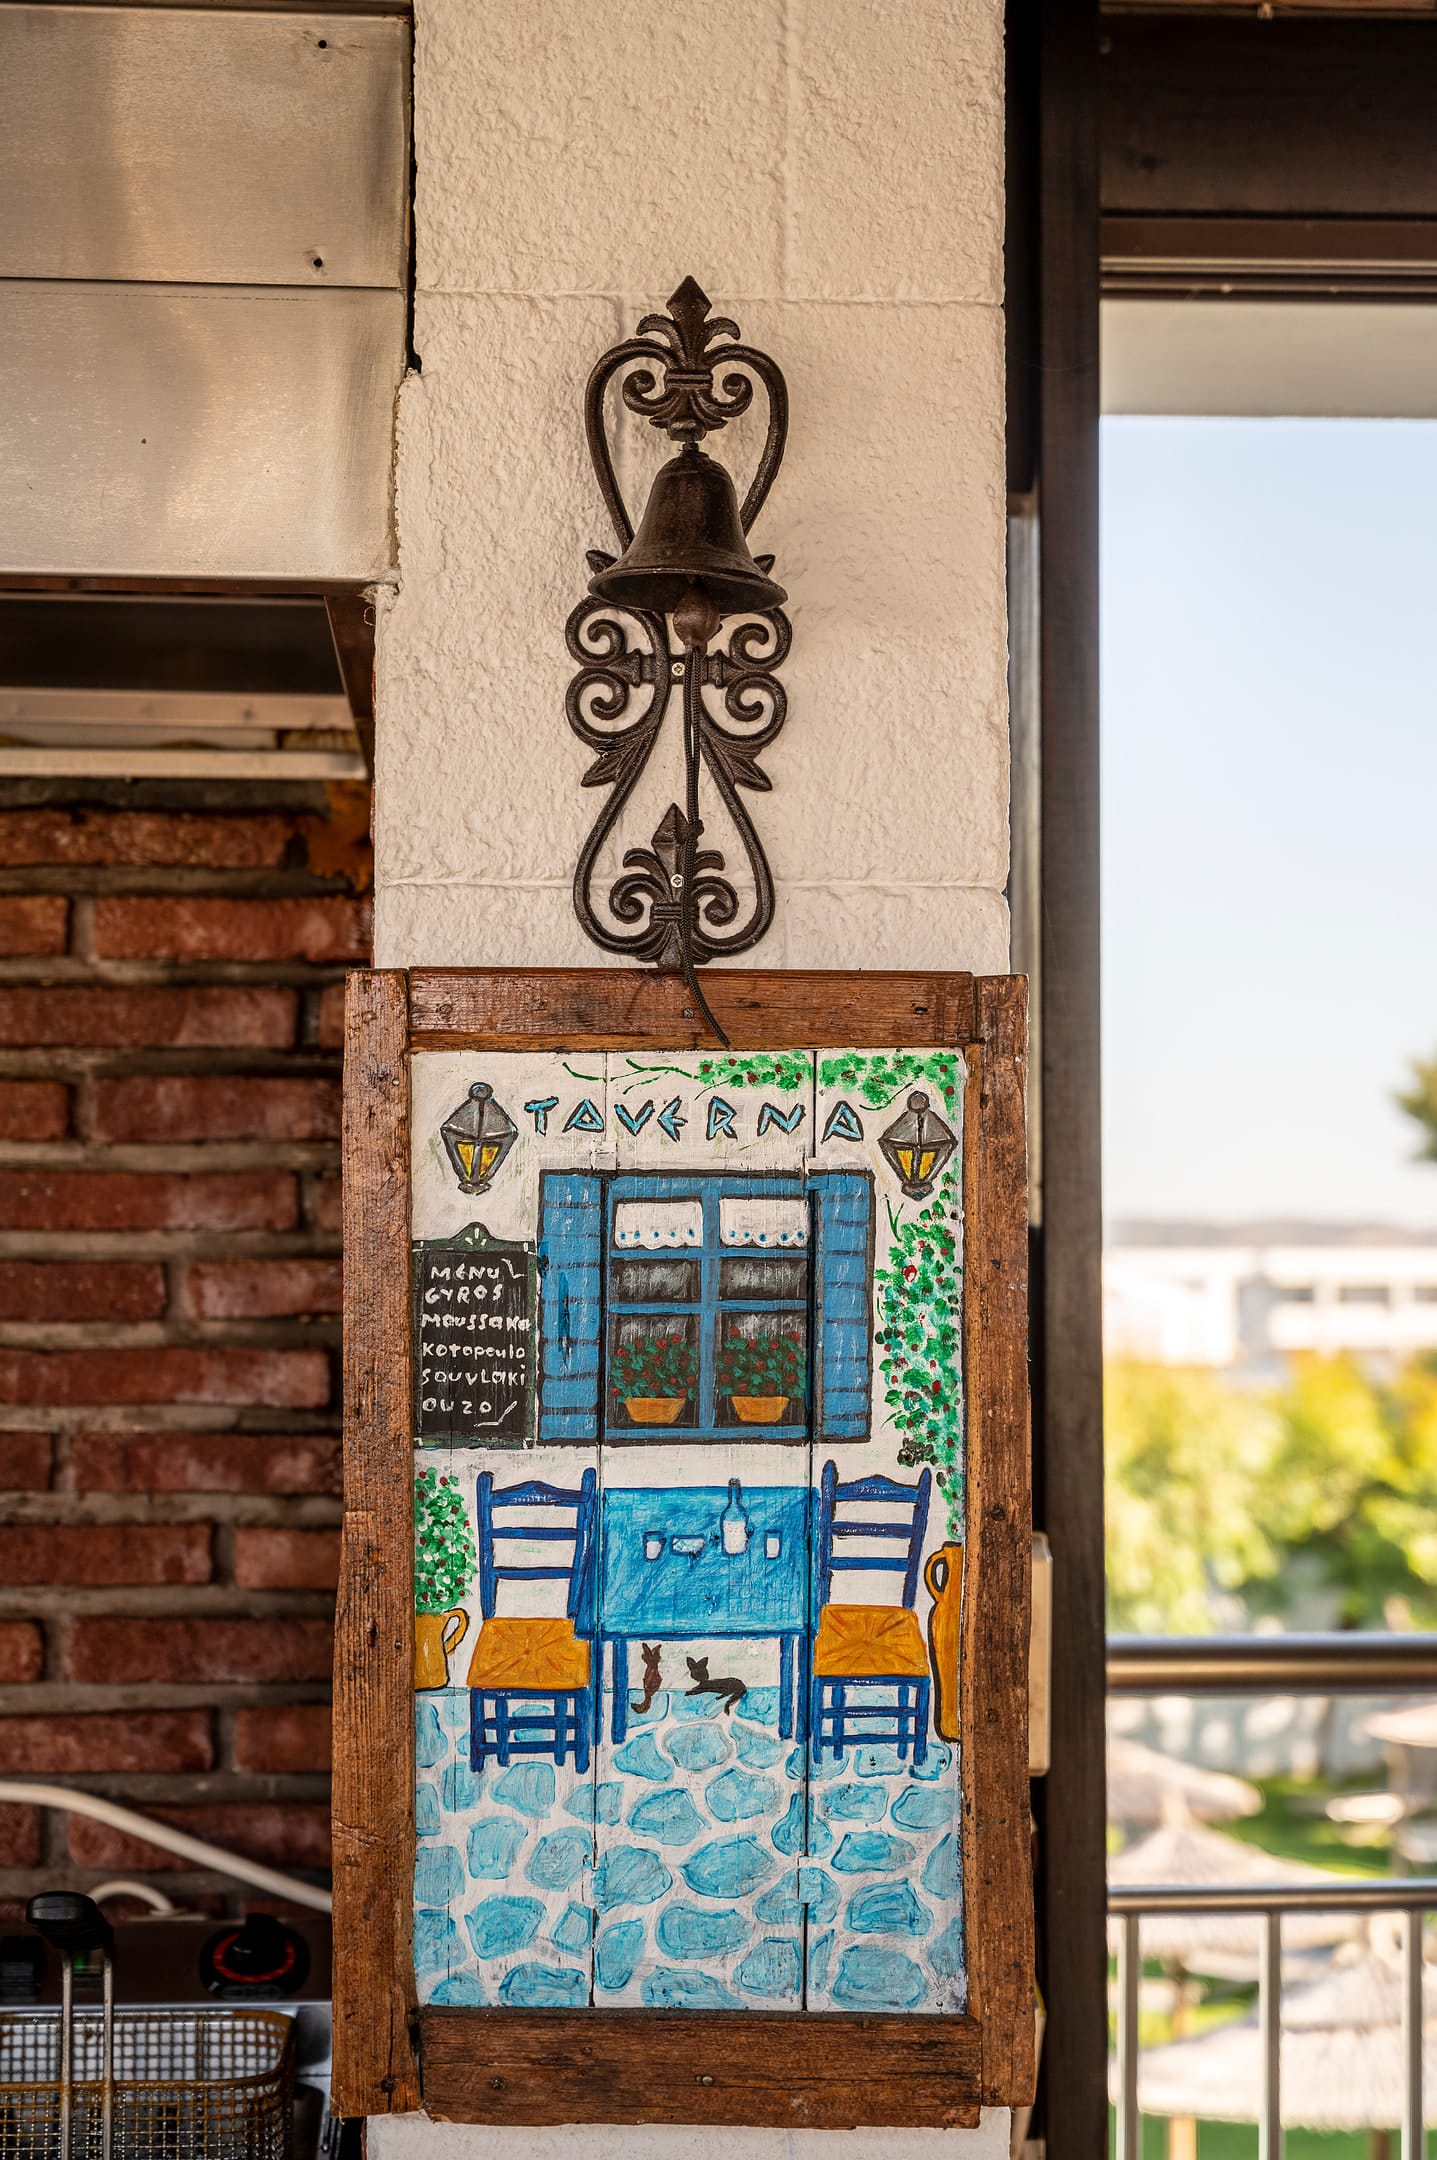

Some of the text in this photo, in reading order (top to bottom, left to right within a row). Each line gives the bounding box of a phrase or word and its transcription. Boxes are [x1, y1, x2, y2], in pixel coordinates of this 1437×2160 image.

[524, 1096, 864, 1142] TAVERNA
[431, 1263, 499, 1281] MENU
[424, 1284, 503, 1304] GYROS
